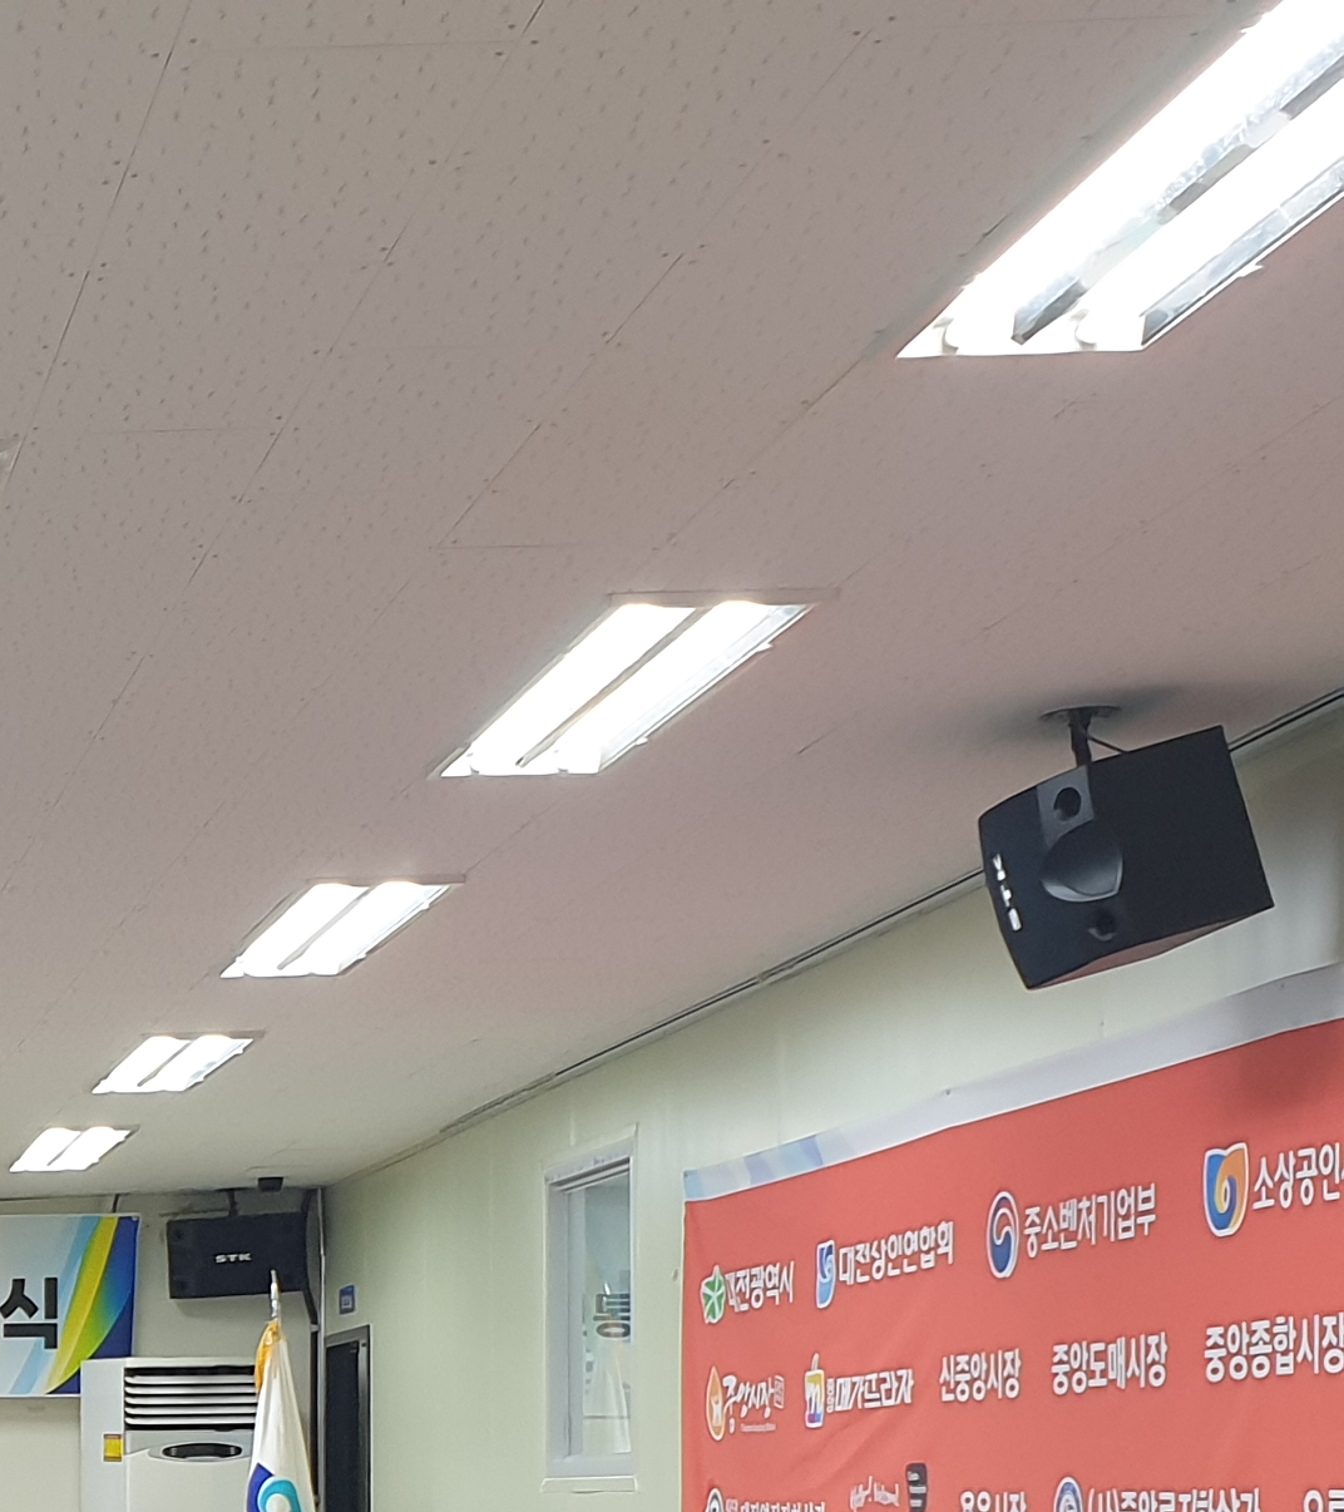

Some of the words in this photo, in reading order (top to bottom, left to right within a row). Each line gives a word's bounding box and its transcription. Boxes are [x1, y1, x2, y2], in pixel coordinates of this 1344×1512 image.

[1251, 1142, 1344, 1212] 소상공인
[838, 1221, 955, 1285] 대전상인연합회
[1023, 1183, 1157, 1258] 중소벤처기업부
[215, 1252, 252, 1263] STK
[939, 1347, 1022, 1402] 신중앙시장
[1051, 1331, 1168, 1396] 중앙도매시장
[1204, 1312, 1344, 1383] 중앙종합시장
